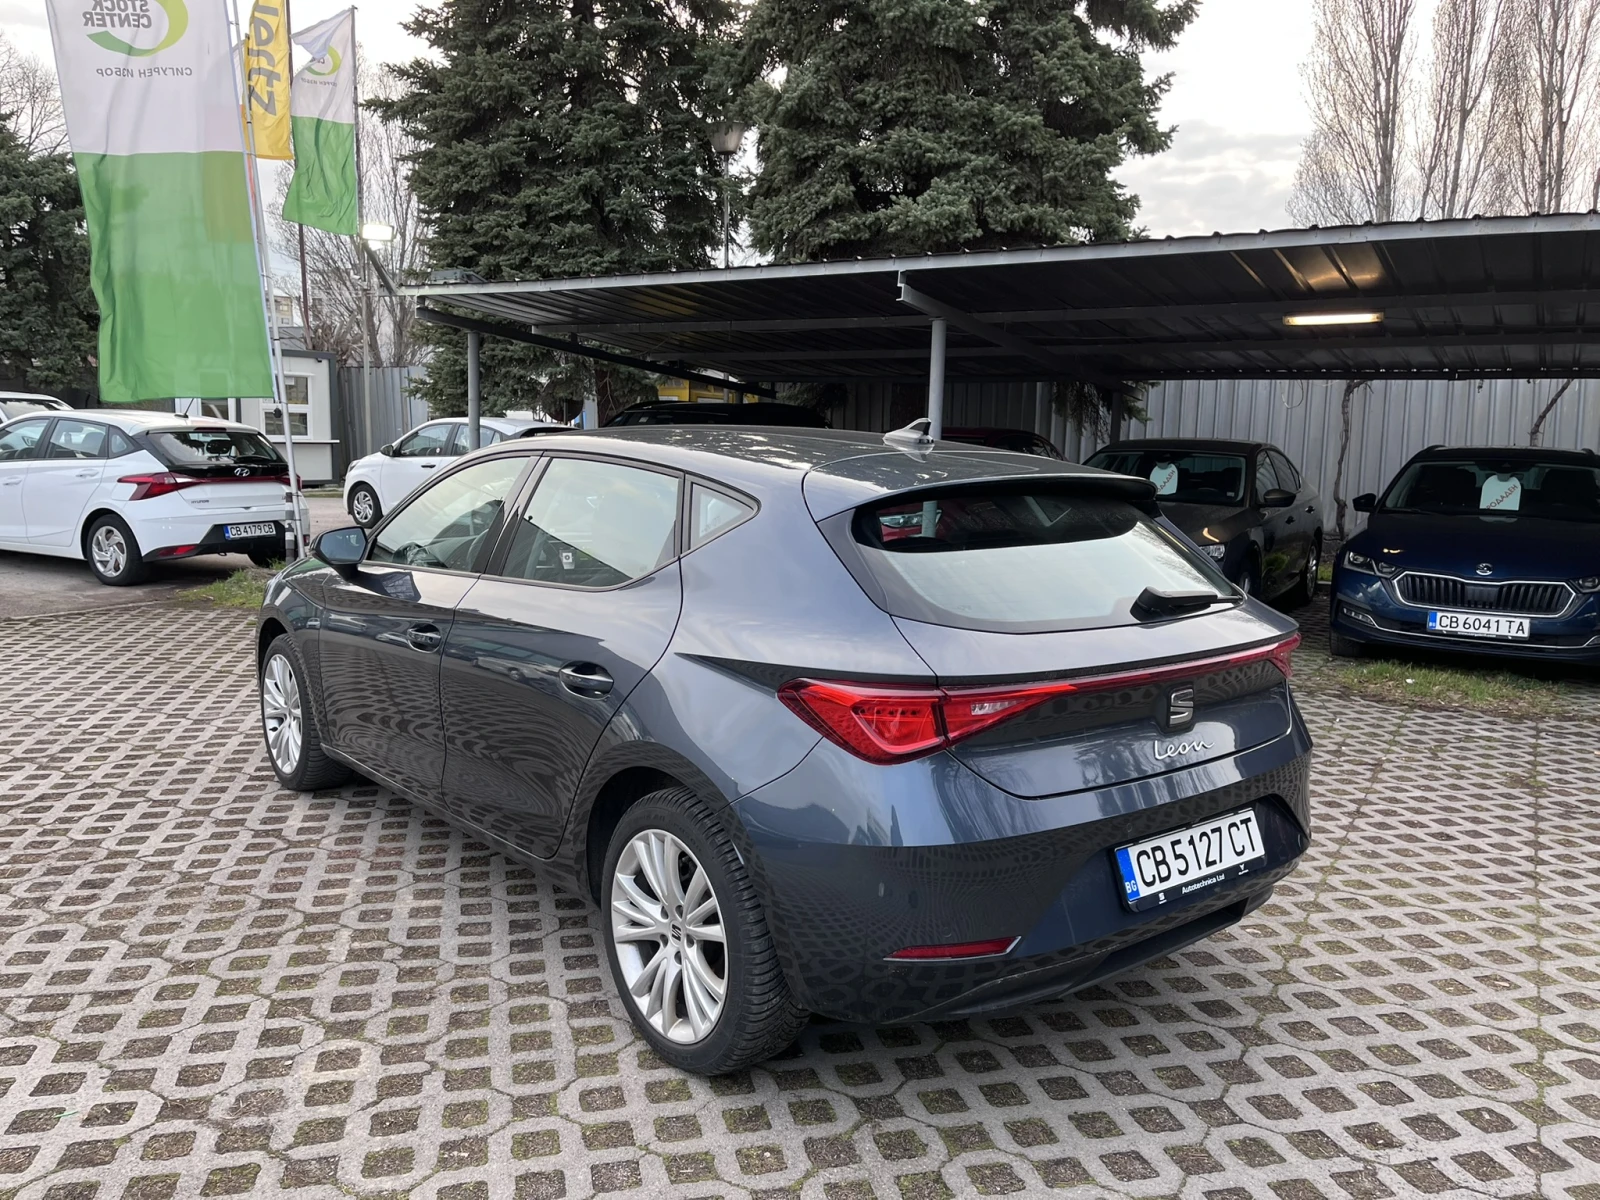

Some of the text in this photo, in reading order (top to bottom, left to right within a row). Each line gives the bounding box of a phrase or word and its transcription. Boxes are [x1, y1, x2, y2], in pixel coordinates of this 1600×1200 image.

[229, 526, 242, 537] CB
[243, 524, 263, 535] 4179
[263, 523, 274, 534] CB
[1439, 615, 1459, 629] CB
[1462, 617, 1501, 633] 6041
[1506, 620, 1525, 635] TA
[1154, 740, 1215, 760] Leon
[1136, 817, 1256, 887] CB 5127 CT
[1124, 880, 1137, 894] BG
[1182, 873, 1226, 894] Autotechnica Ltd
